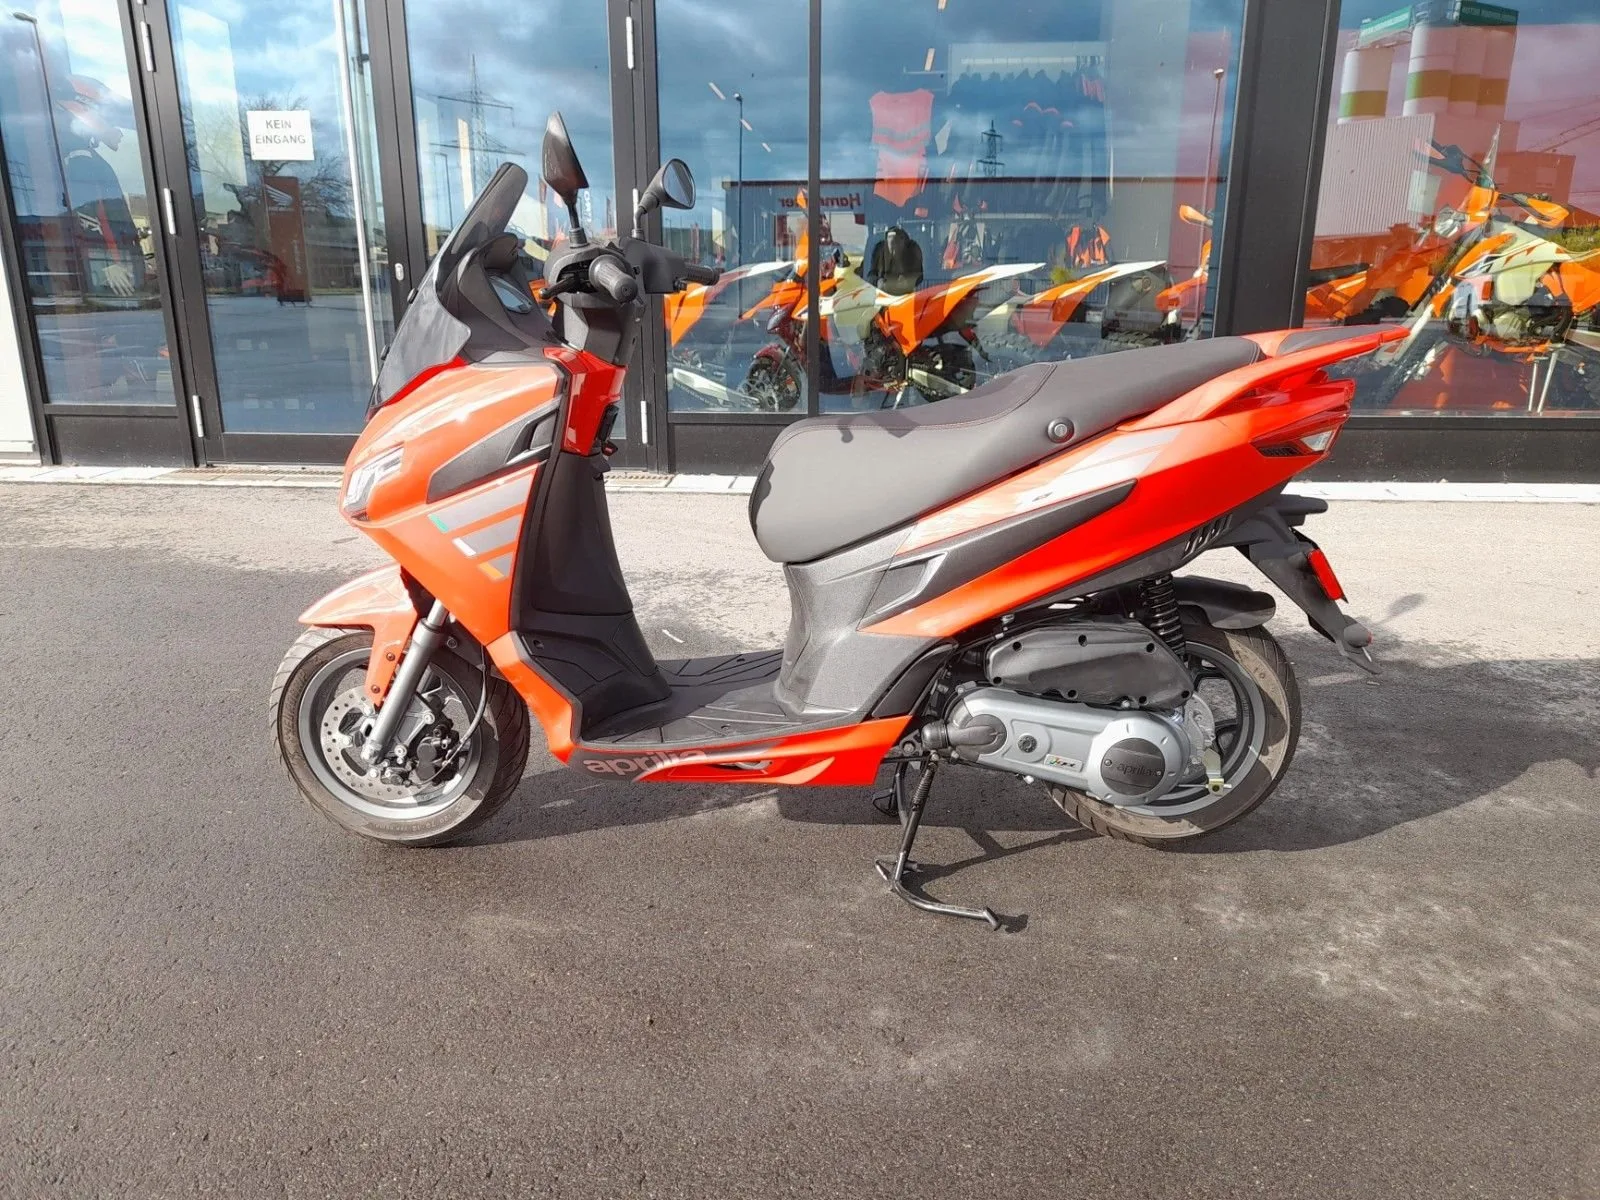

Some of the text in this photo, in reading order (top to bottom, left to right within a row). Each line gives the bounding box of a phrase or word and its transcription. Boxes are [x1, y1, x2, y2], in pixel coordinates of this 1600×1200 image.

[265, 119, 292, 129] KEIN
[255, 134, 306, 144] EINGANG
[583, 749, 707, 776] aprilia
[1116, 763, 1154, 777] aprilia
